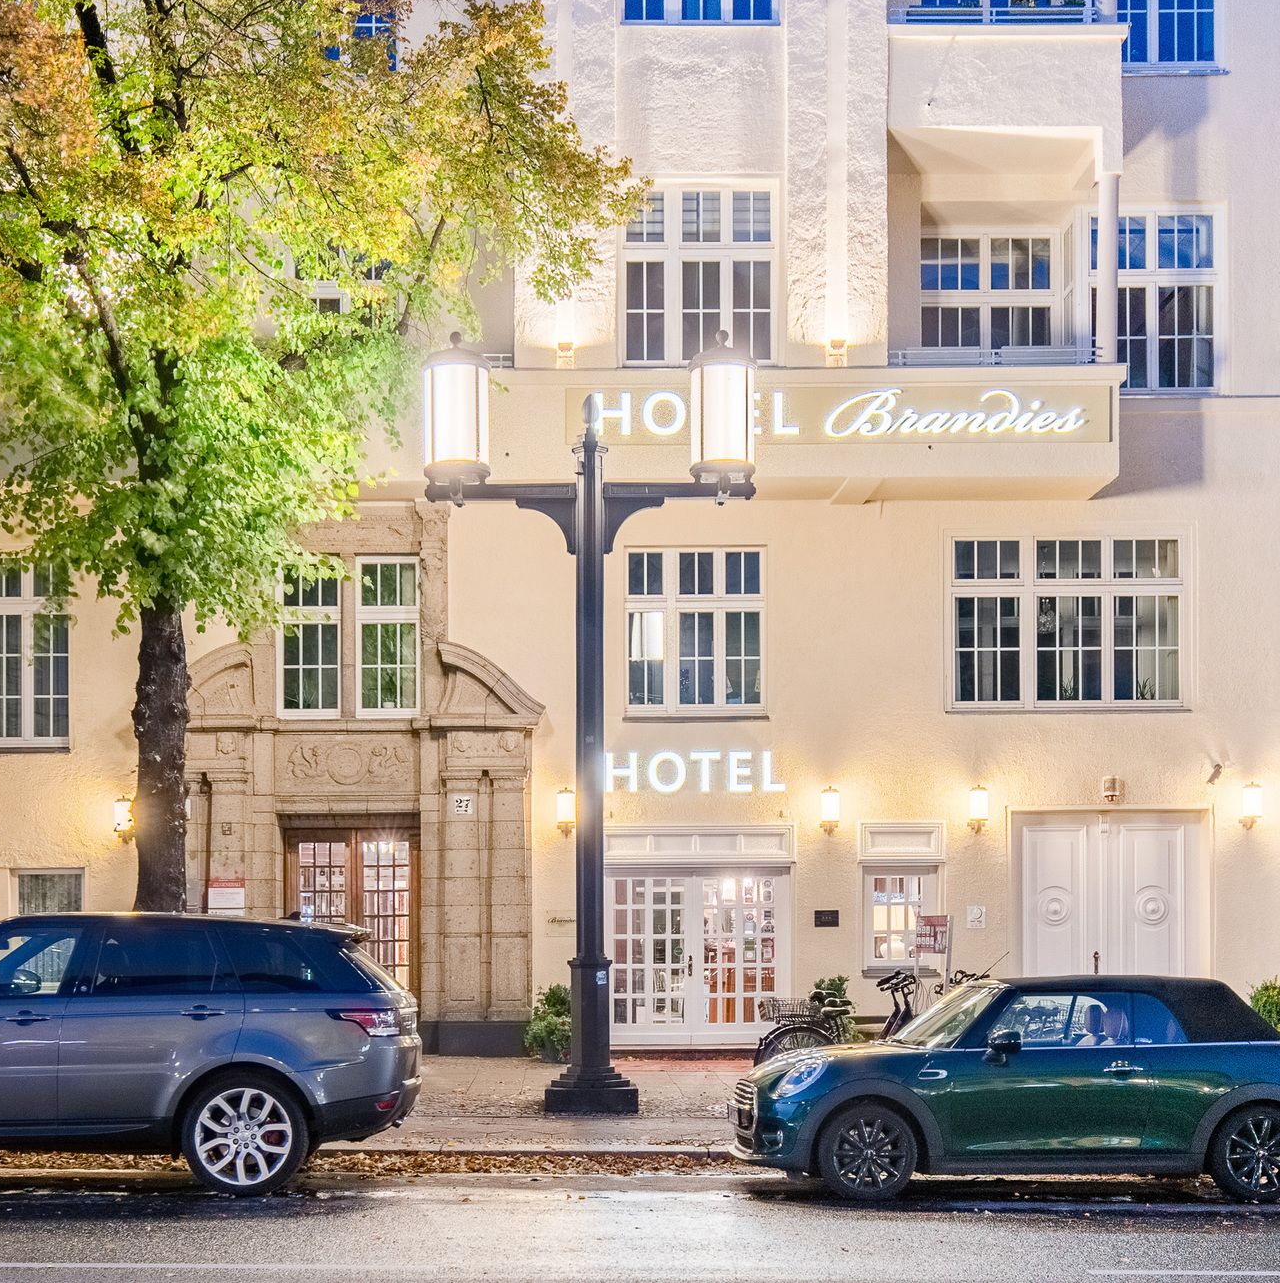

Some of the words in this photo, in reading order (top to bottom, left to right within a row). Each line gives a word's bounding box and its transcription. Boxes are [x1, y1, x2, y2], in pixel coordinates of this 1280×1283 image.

[593, 390, 800, 436] HOL
[824, 388, 1087, 438] Brandies
[605, 751, 786, 793] HOTEL
[455, 798, 471, 809] 27
